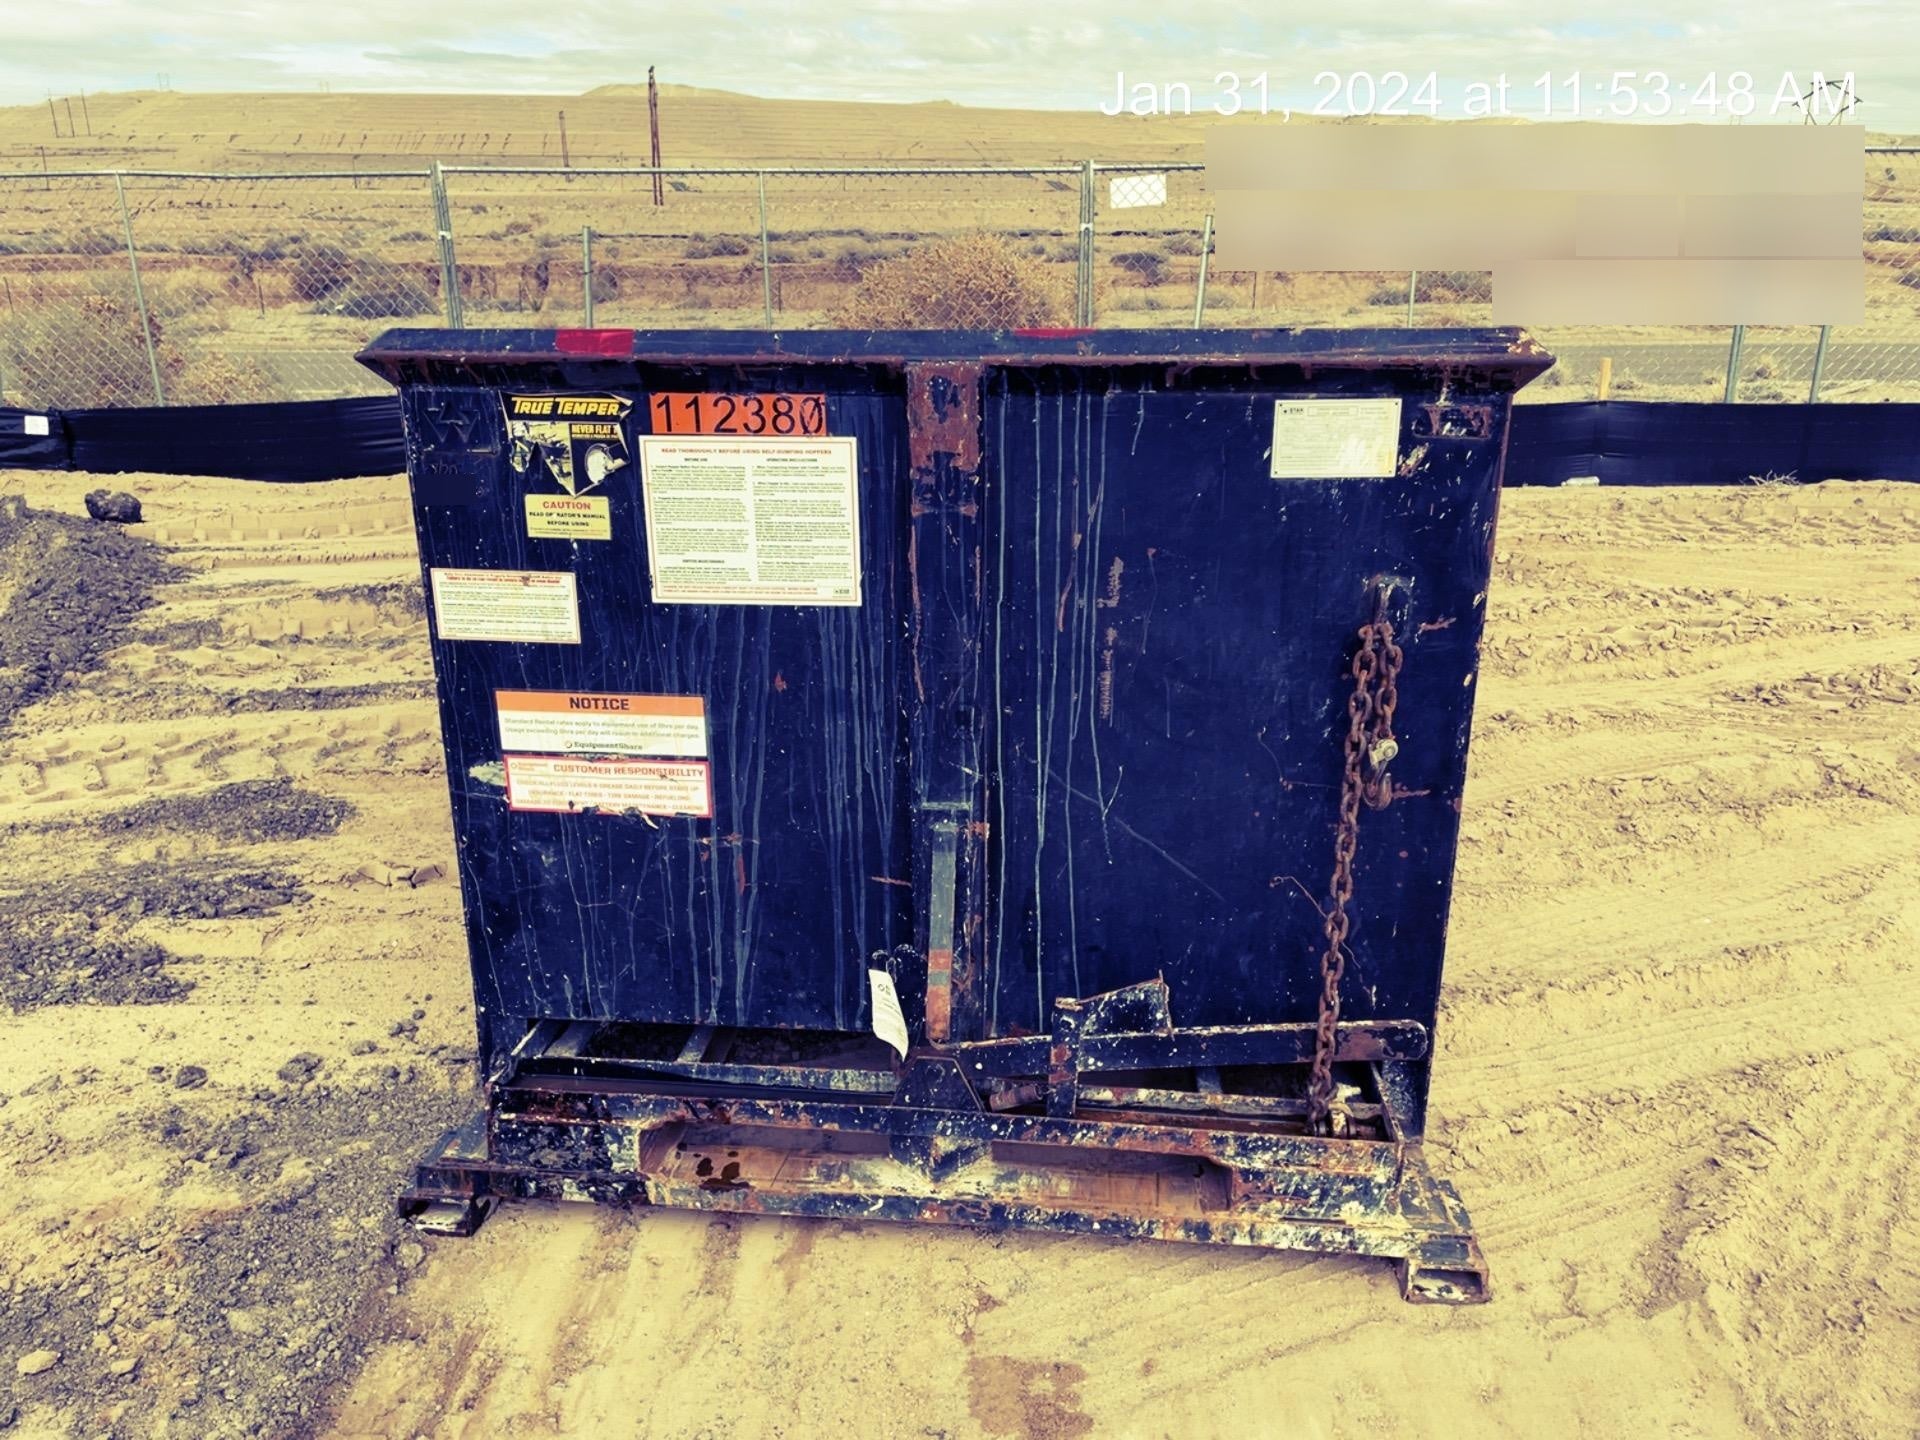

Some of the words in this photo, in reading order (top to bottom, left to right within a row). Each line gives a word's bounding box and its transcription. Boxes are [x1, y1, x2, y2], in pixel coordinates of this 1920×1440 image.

[511, 397, 553, 414] TRUE
[555, 397, 620, 416] TEMPER
[656, 394, 824, 434] 112380
[542, 500, 592, 510] CAUTION
[569, 697, 630, 711] NOTICE
[574, 741, 643, 750] EquipmentShare
[553, 764, 611, 774] CUSTOMER
[614, 767, 704, 777] RESPONSIBILITY
